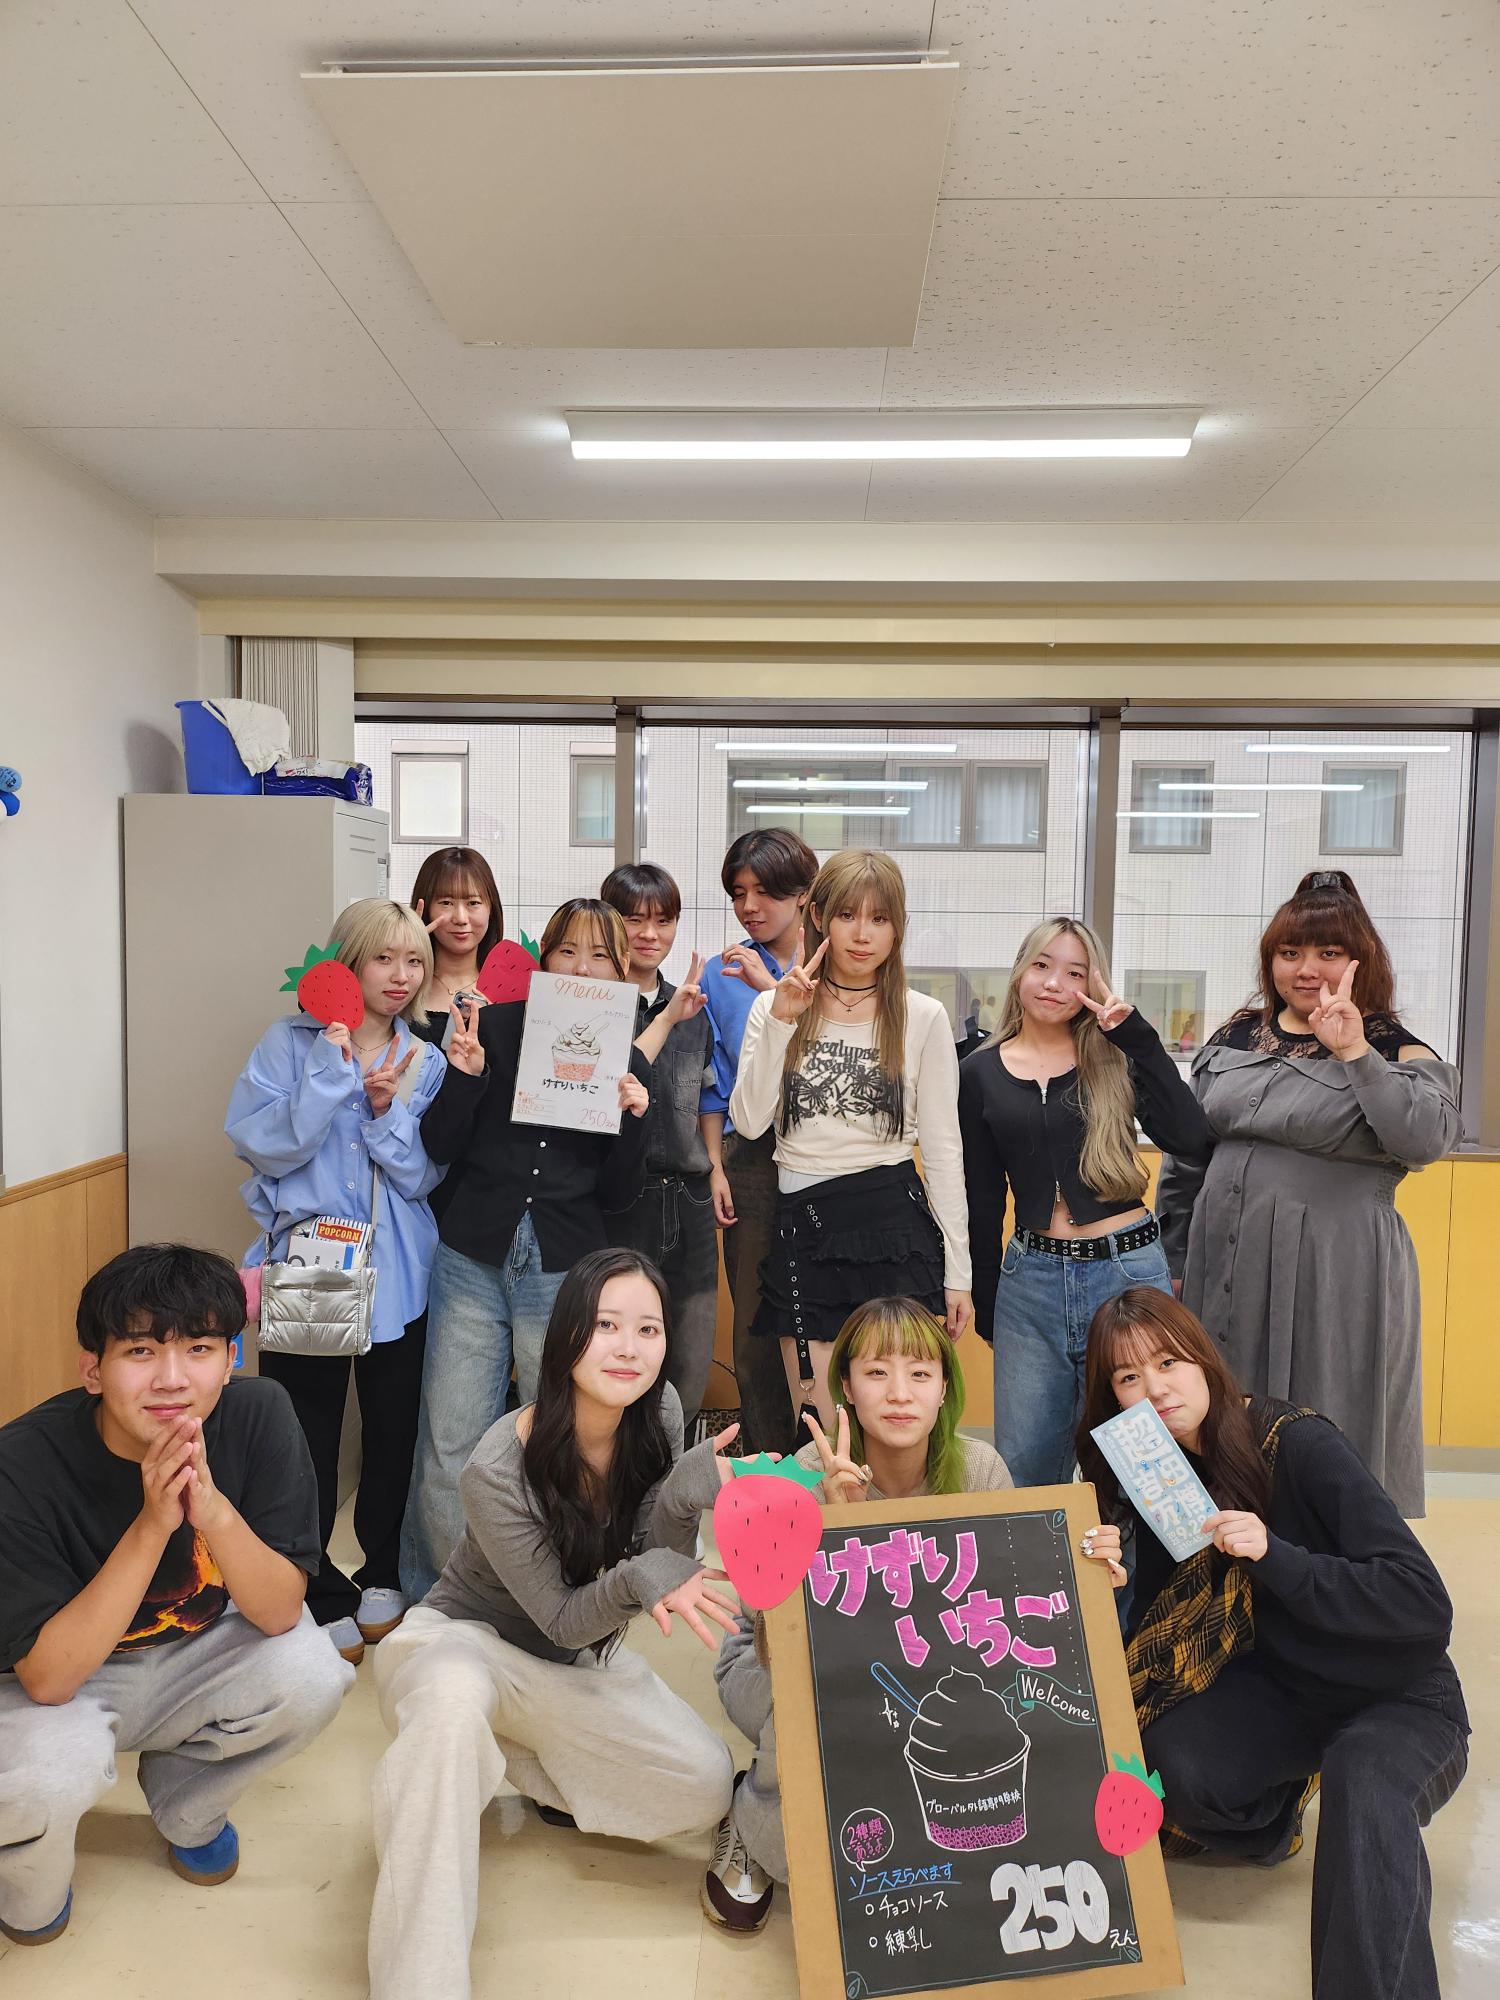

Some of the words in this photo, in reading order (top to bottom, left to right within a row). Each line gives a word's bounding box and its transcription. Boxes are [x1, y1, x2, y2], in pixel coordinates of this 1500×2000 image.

[580, 1107, 607, 1128] 250
[319, 1226, 361, 1242] POPCORN
[808, 1529, 978, 1617] けずり
[895, 1590, 1070, 1668] いちご
[850, 1862, 953, 1896] ソースえらべます
[878, 1891, 949, 1918] チョコソース
[990, 1860, 1110, 1954] 250
[1109, 1928, 1138, 1949] えん
[885, 1925, 932, 1956] 練乳
